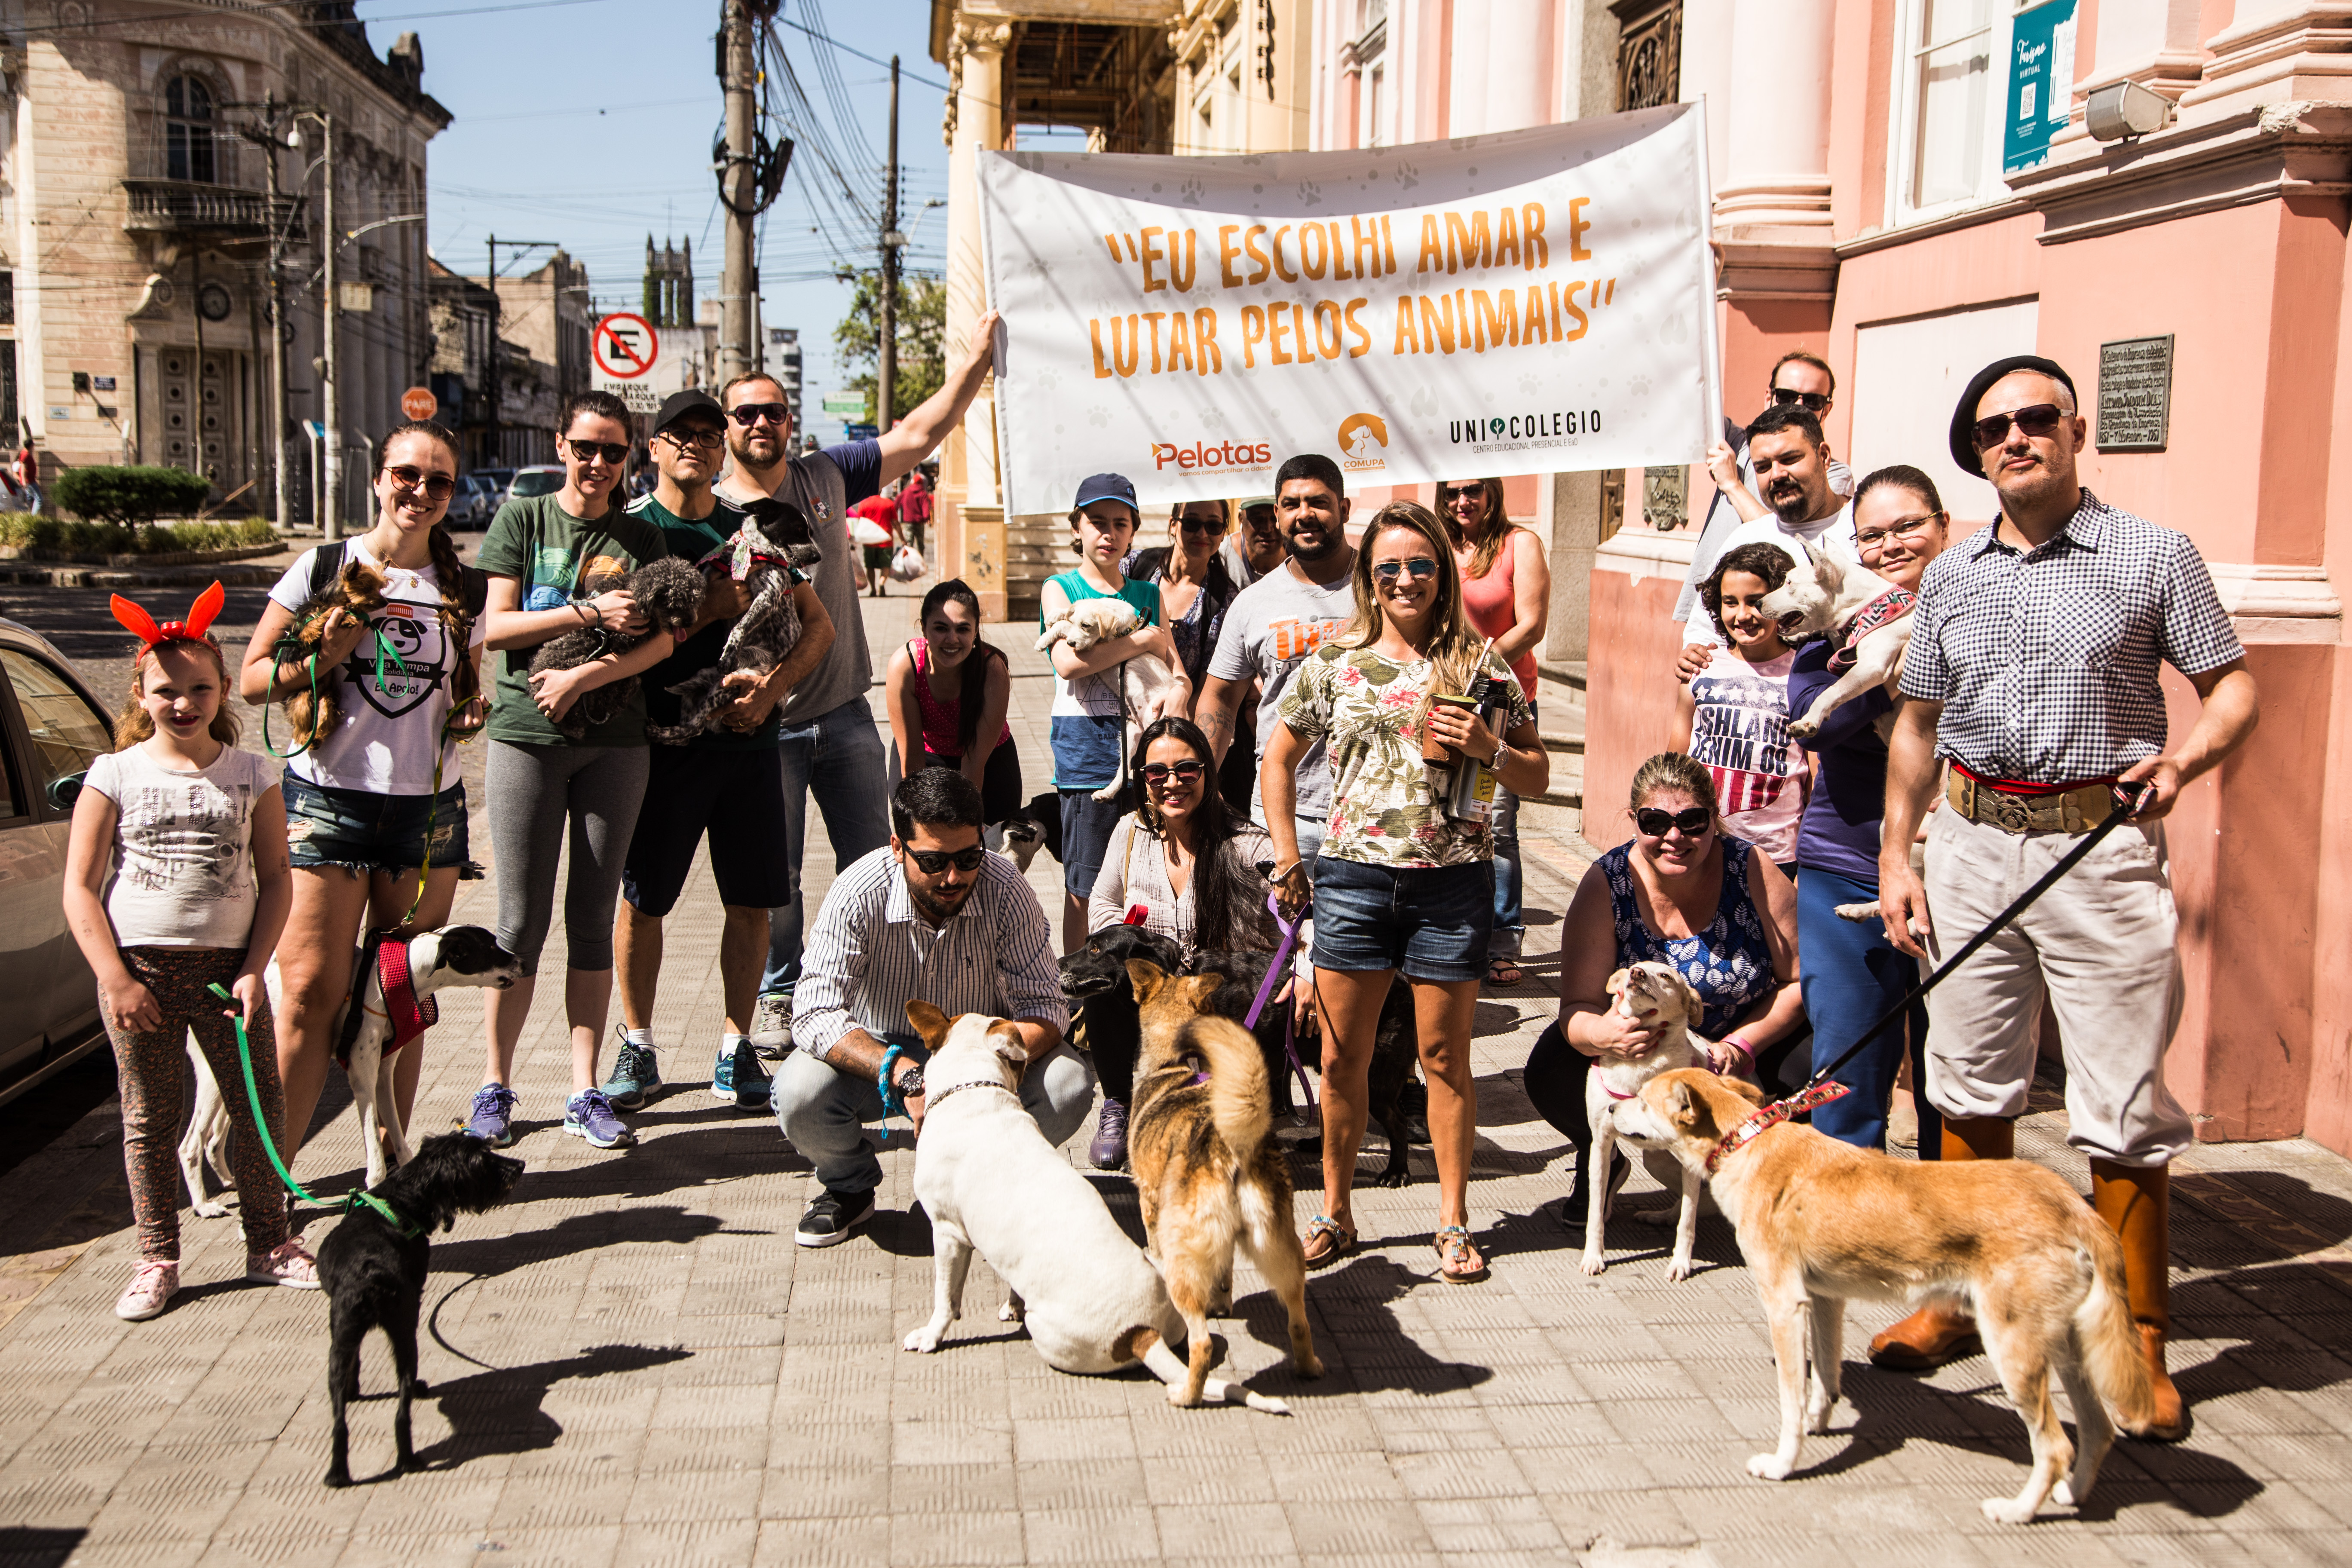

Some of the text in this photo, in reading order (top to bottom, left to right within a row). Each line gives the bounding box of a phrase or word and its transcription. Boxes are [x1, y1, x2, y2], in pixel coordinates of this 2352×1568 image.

[2017, 39, 2046, 65] Turismo
[2019, 64, 2040, 79] VIRTUAL
[1105, 197, 1591, 293] "EU ESCOLHI AMAR E
[1090, 278, 1616, 379] LUTAR PELOS ANIMAIS"
[405, 399, 434, 411] PARE
[1510, 410, 1601, 439] COLEGIO
[1473, 438, 1578, 453] CENTRO EDUCACIONAL PRESENCIAL E EaD
[1155, 440, 1271, 470] Pelotas
[1344, 458, 1385, 468] COMUPA
[1202, 467, 1243, 475] compartilhar
[394, 661, 429, 673] Tmpa
[1275, 661, 1302, 674] FIT
[389, 683, 419, 695] Apoio!
[1691, 732, 1788, 776] DENIM 08
